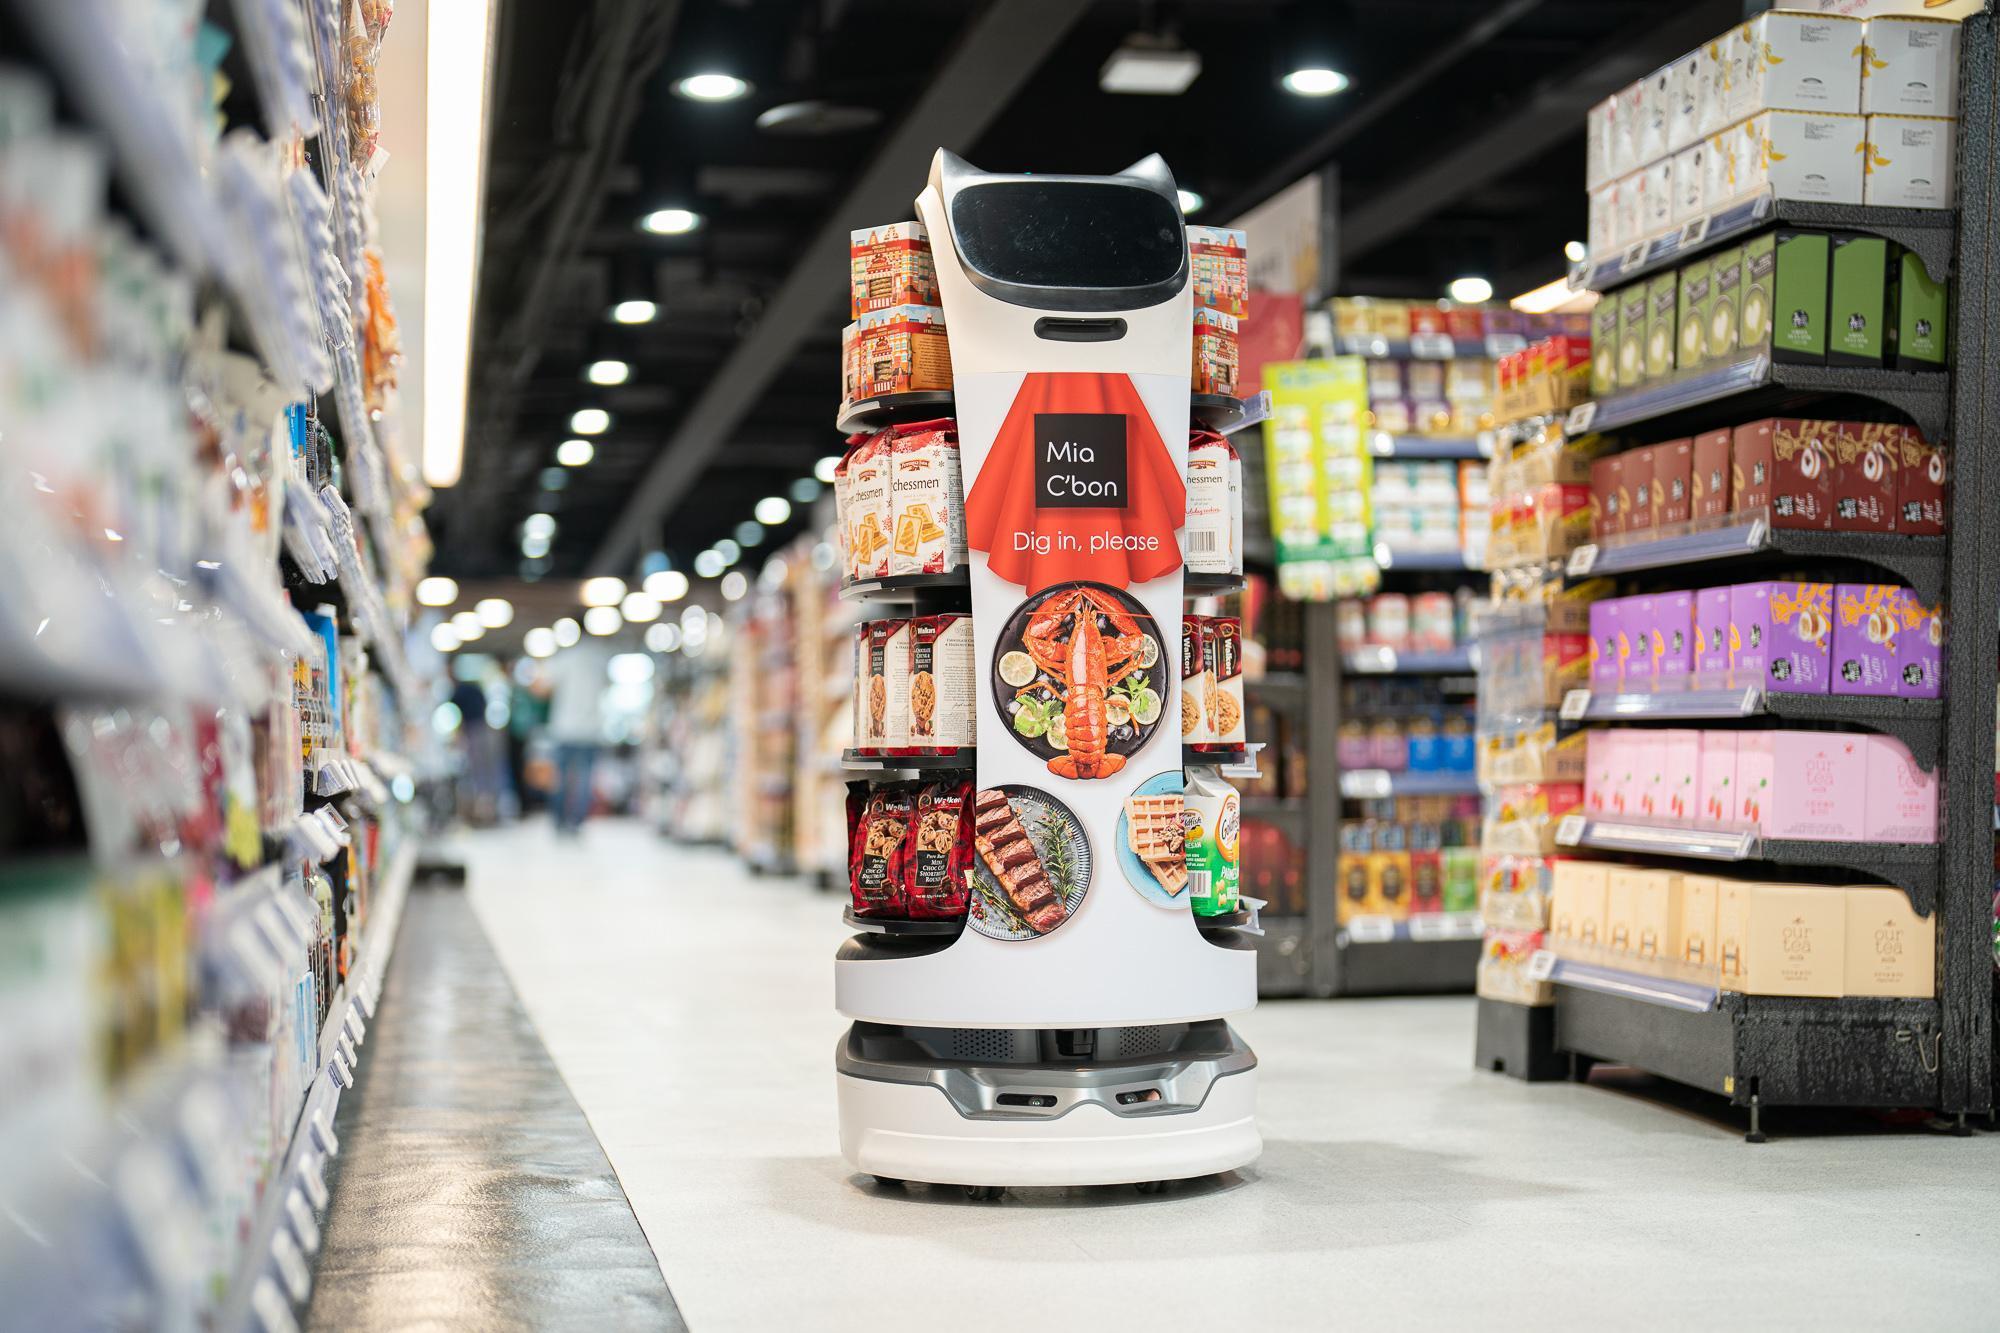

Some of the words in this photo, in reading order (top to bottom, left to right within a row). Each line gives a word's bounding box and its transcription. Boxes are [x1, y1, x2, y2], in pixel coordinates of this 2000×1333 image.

[1046, 441, 1094, 462] Mia
[892, 478, 939, 491] chessmen
[1046, 474, 1117, 496] C'bon
[1186, 475, 1222, 484] hessmen
[1013, 531, 1050, 554] Dig
[1057, 530, 1083, 552] in,
[1090, 531, 1159, 554] please
[1183, 637, 1191, 675] Walkers
[1224, 638, 1232, 675] Walkers
